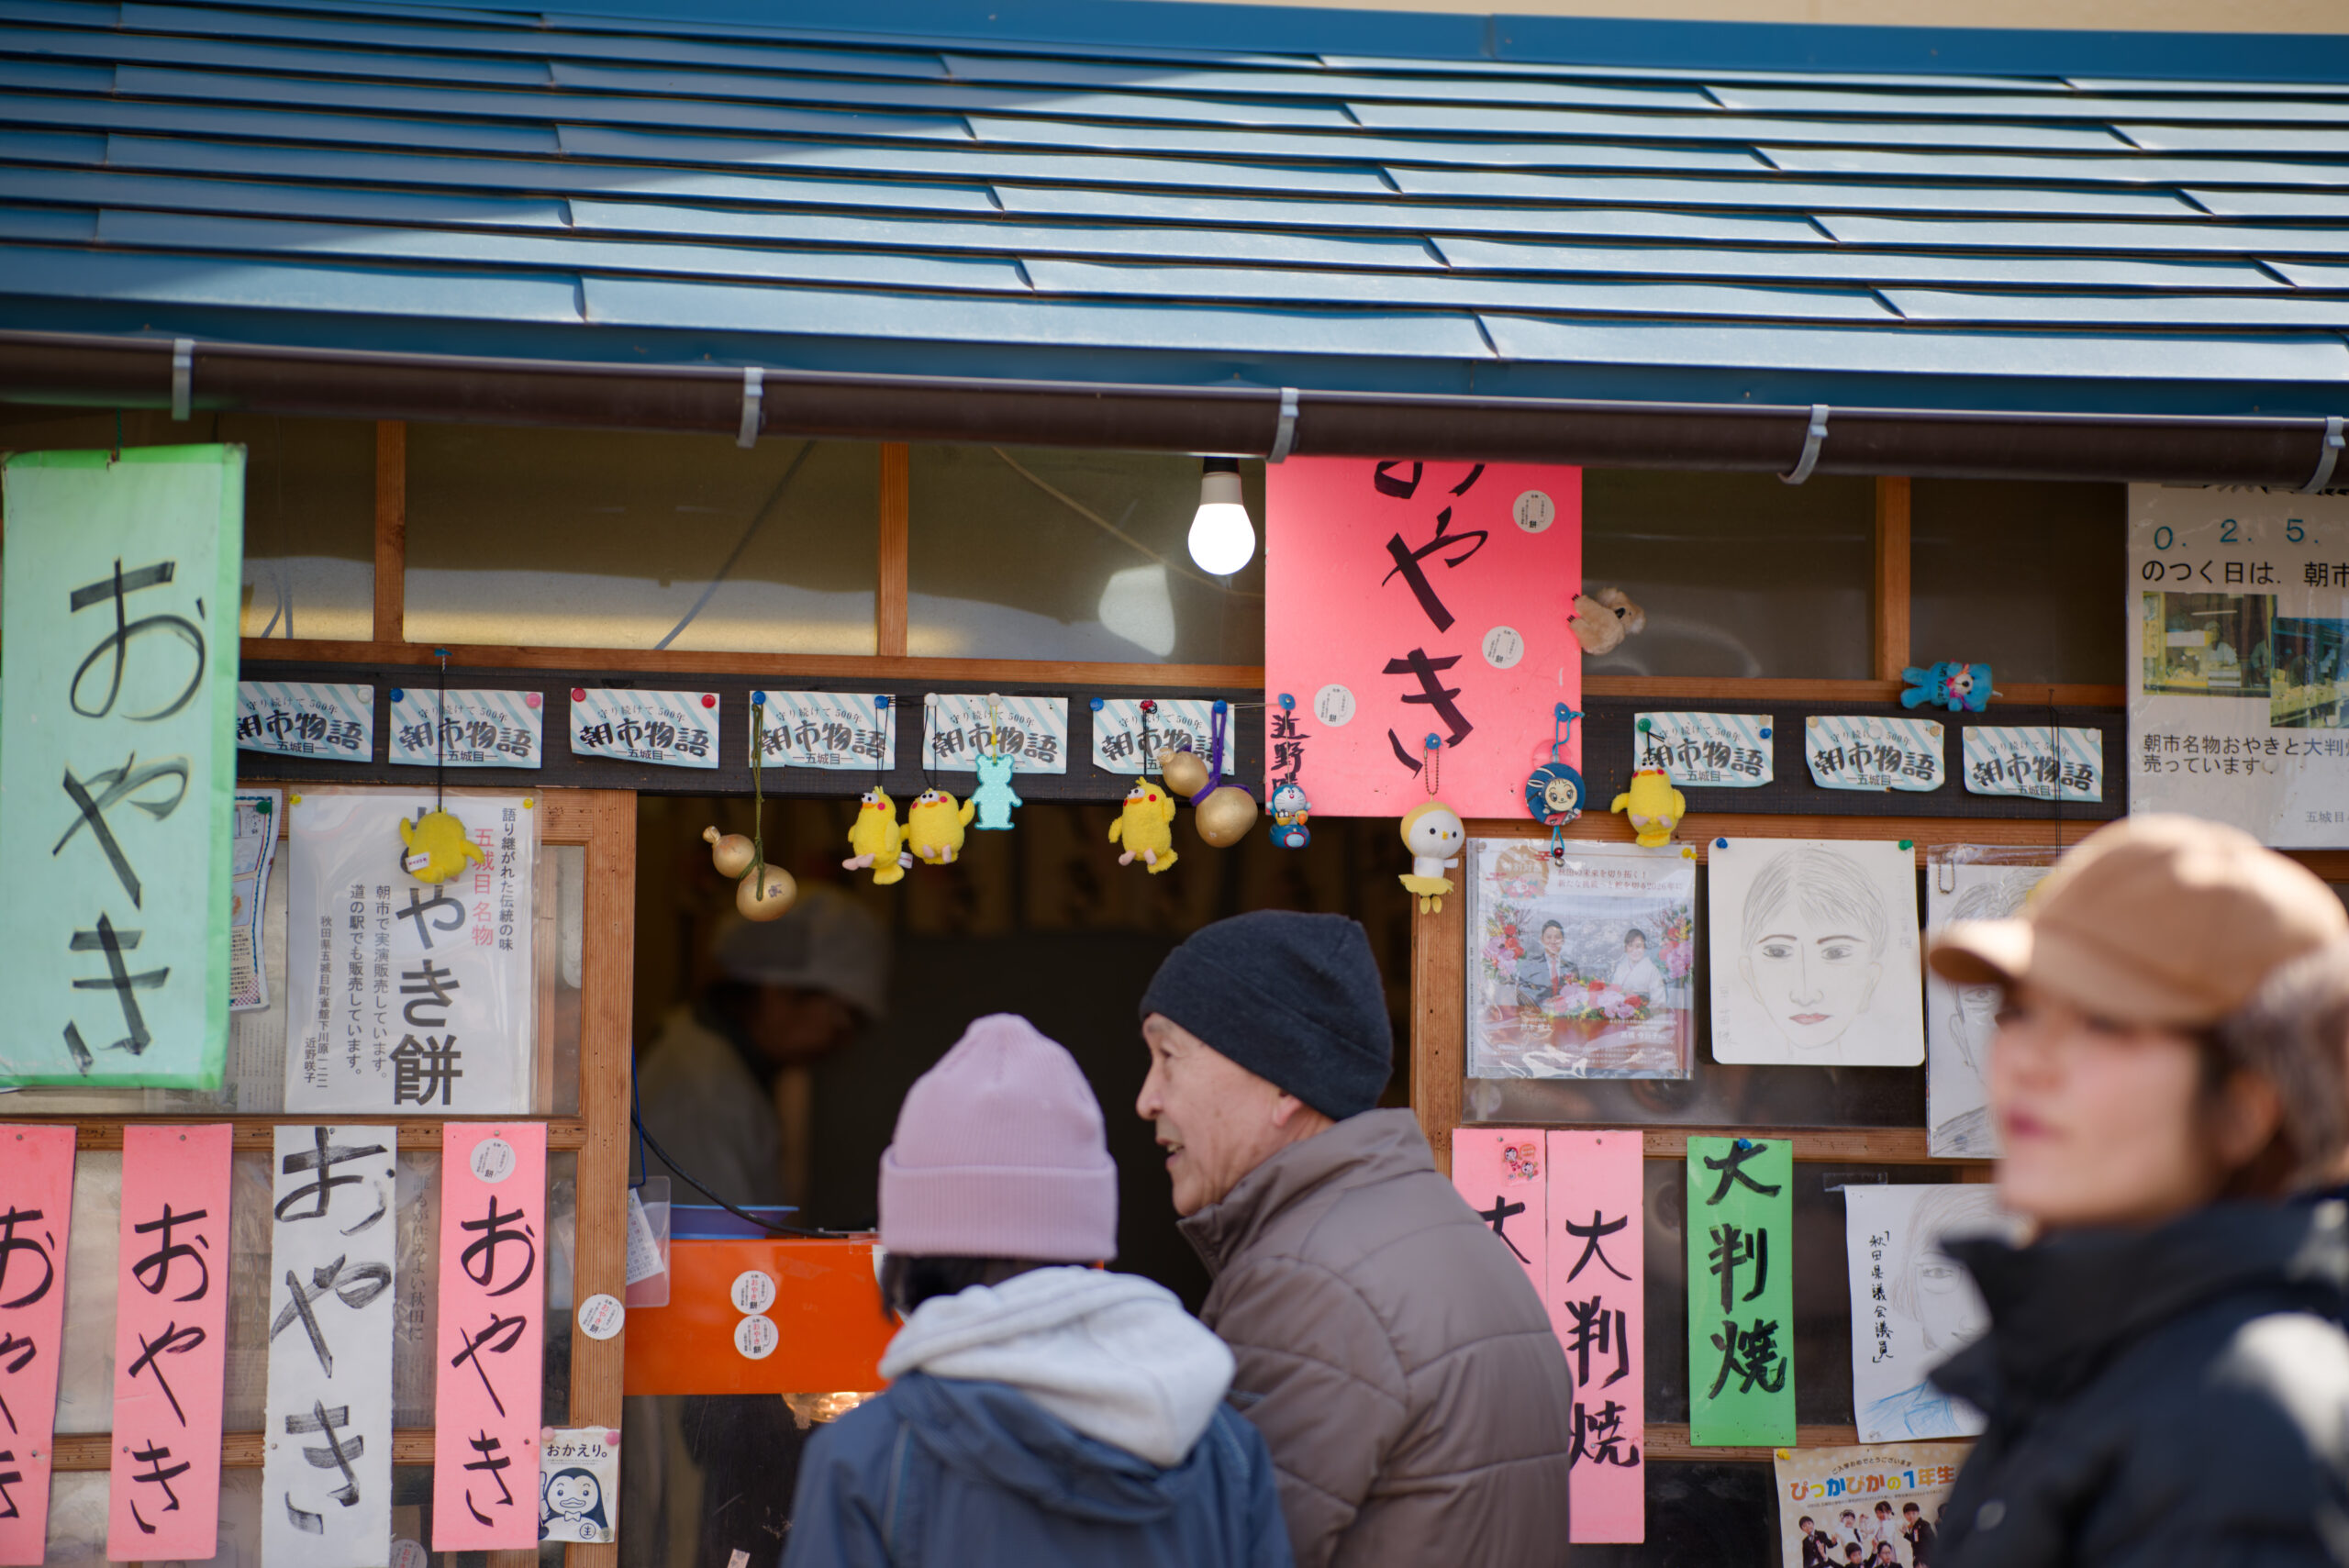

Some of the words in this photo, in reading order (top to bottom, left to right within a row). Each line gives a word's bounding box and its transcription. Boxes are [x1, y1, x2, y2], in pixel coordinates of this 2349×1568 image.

[658, 707, 685, 722] 500年
[835, 709, 863, 725] 500年
[1008, 712, 1035, 728] 500年
[1176, 715, 1203, 730] 500年
[399, 717, 533, 758] 朝市物語
[447, 750, 485, 763] 五城目
[579, 717, 710, 757] 朝市物語
[628, 748, 664, 762] 五城目
[758, 719, 887, 760] 朝市物語
[931, 723, 1058, 763] 朝市物語
[2143, 734, 2349, 757] 朝市名物おやきと大判
[805, 751, 841, 765] 五城目
[1687, 770, 1720, 782] 五城目
[1814, 741, 1935, 781] 朝市物語
[1973, 753, 2093, 791] 朝市物語
[52, 556, 205, 1076] おやき
[498, 807, 517, 951] 語り継がれた伝統の味
[472, 900, 494, 946] 名物
[389, 806, 466, 1106] やき餅
[346, 884, 365, 1075] 道の駅でも販売しています。
[371, 885, 391, 1079] 朝市で実演販売しています。
[304, 1037, 317, 1084] 近野咲子
[1702, 1140, 1787, 1400] 大判焼
[270, 1128, 392, 1535] おやき
[1564, 1209, 1641, 1471] 大判焼
[128, 1203, 209, 1534] おやき
[451, 1195, 536, 1527] おやき
[547, 1443, 607, 1458] おかえり。
